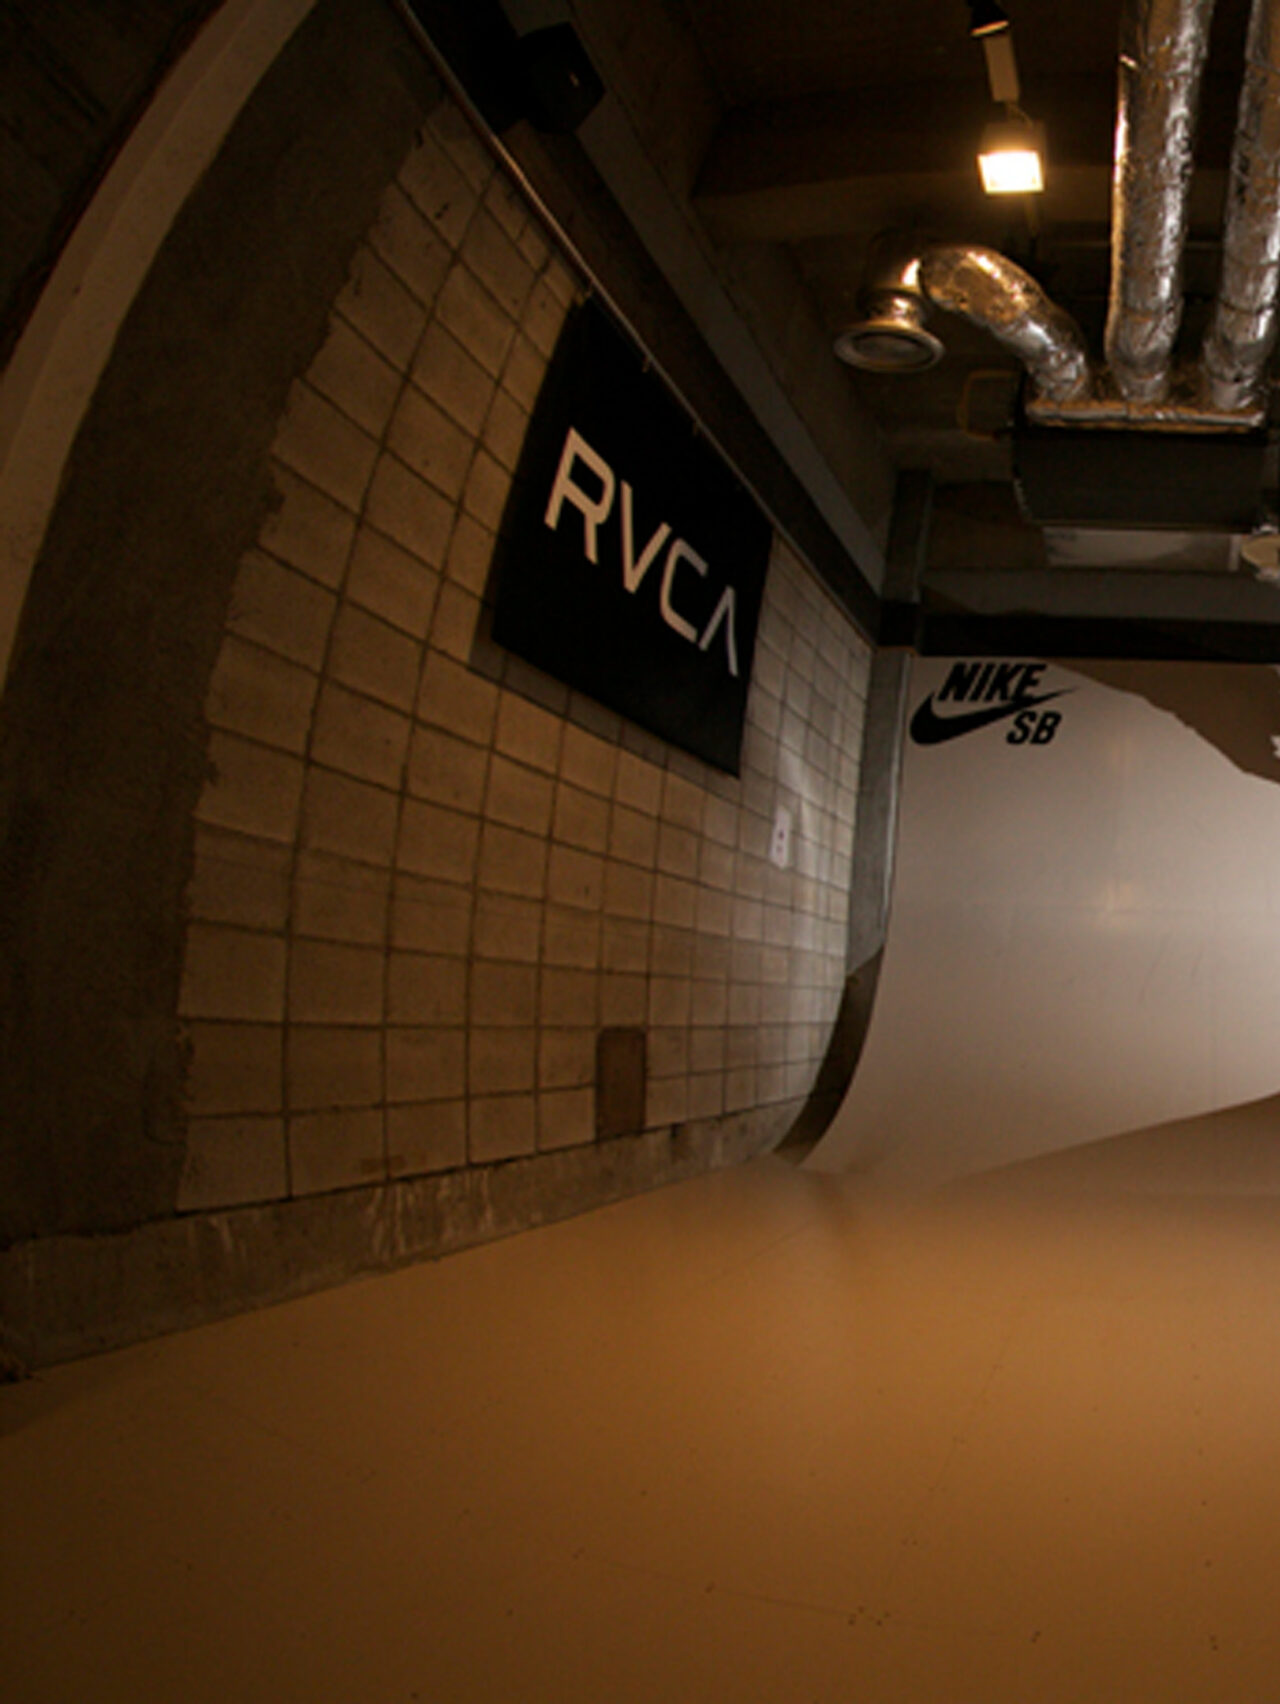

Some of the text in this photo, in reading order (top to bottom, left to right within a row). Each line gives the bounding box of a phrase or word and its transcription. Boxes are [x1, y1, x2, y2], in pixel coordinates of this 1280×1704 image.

[544, 426, 739, 677] RVCA
[938, 662, 1047, 701] NIKE
[1006, 710, 1063, 745] SB
